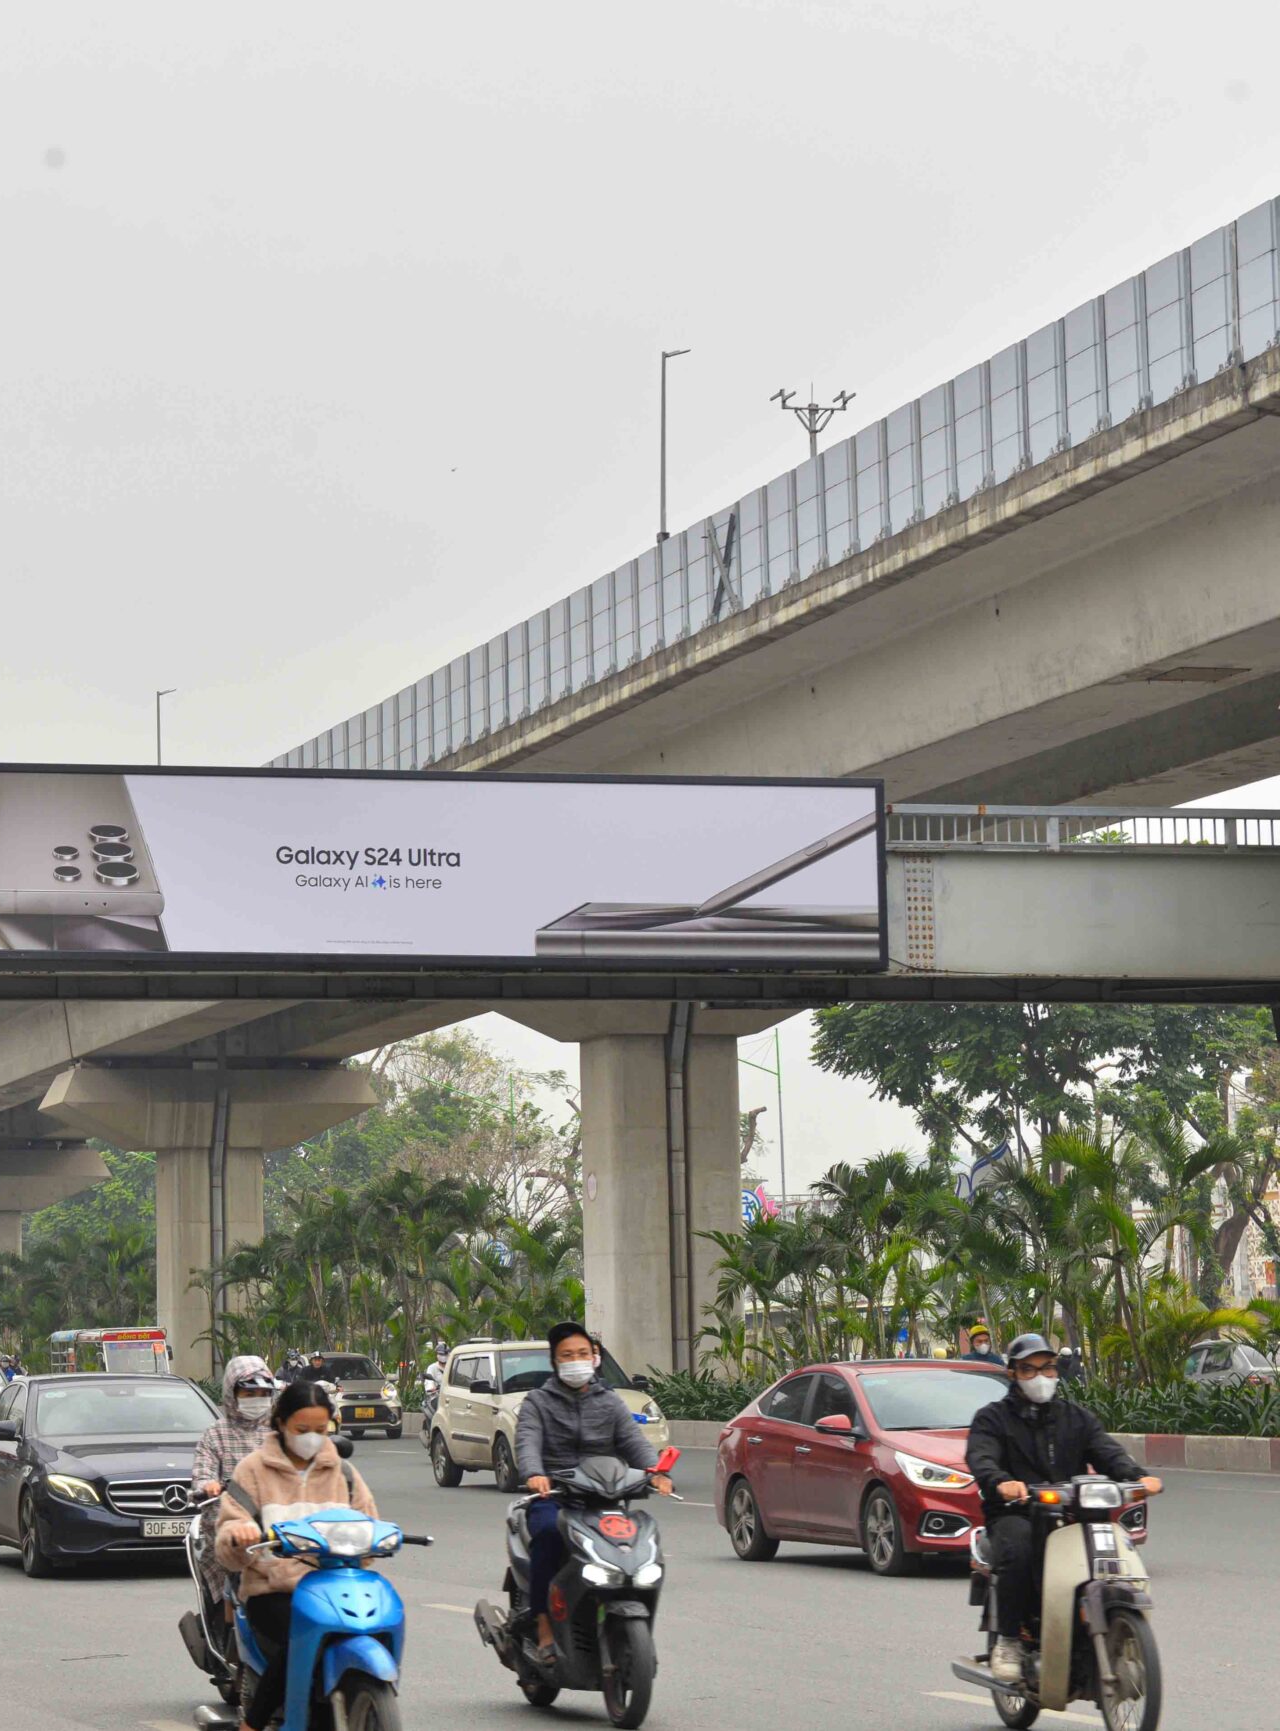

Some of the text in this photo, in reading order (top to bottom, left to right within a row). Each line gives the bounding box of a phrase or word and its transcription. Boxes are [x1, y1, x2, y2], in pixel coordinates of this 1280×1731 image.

[276, 846, 461, 870] Galaxy S24 Ultra
[295, 874, 442, 891] Galaxy AI is here
